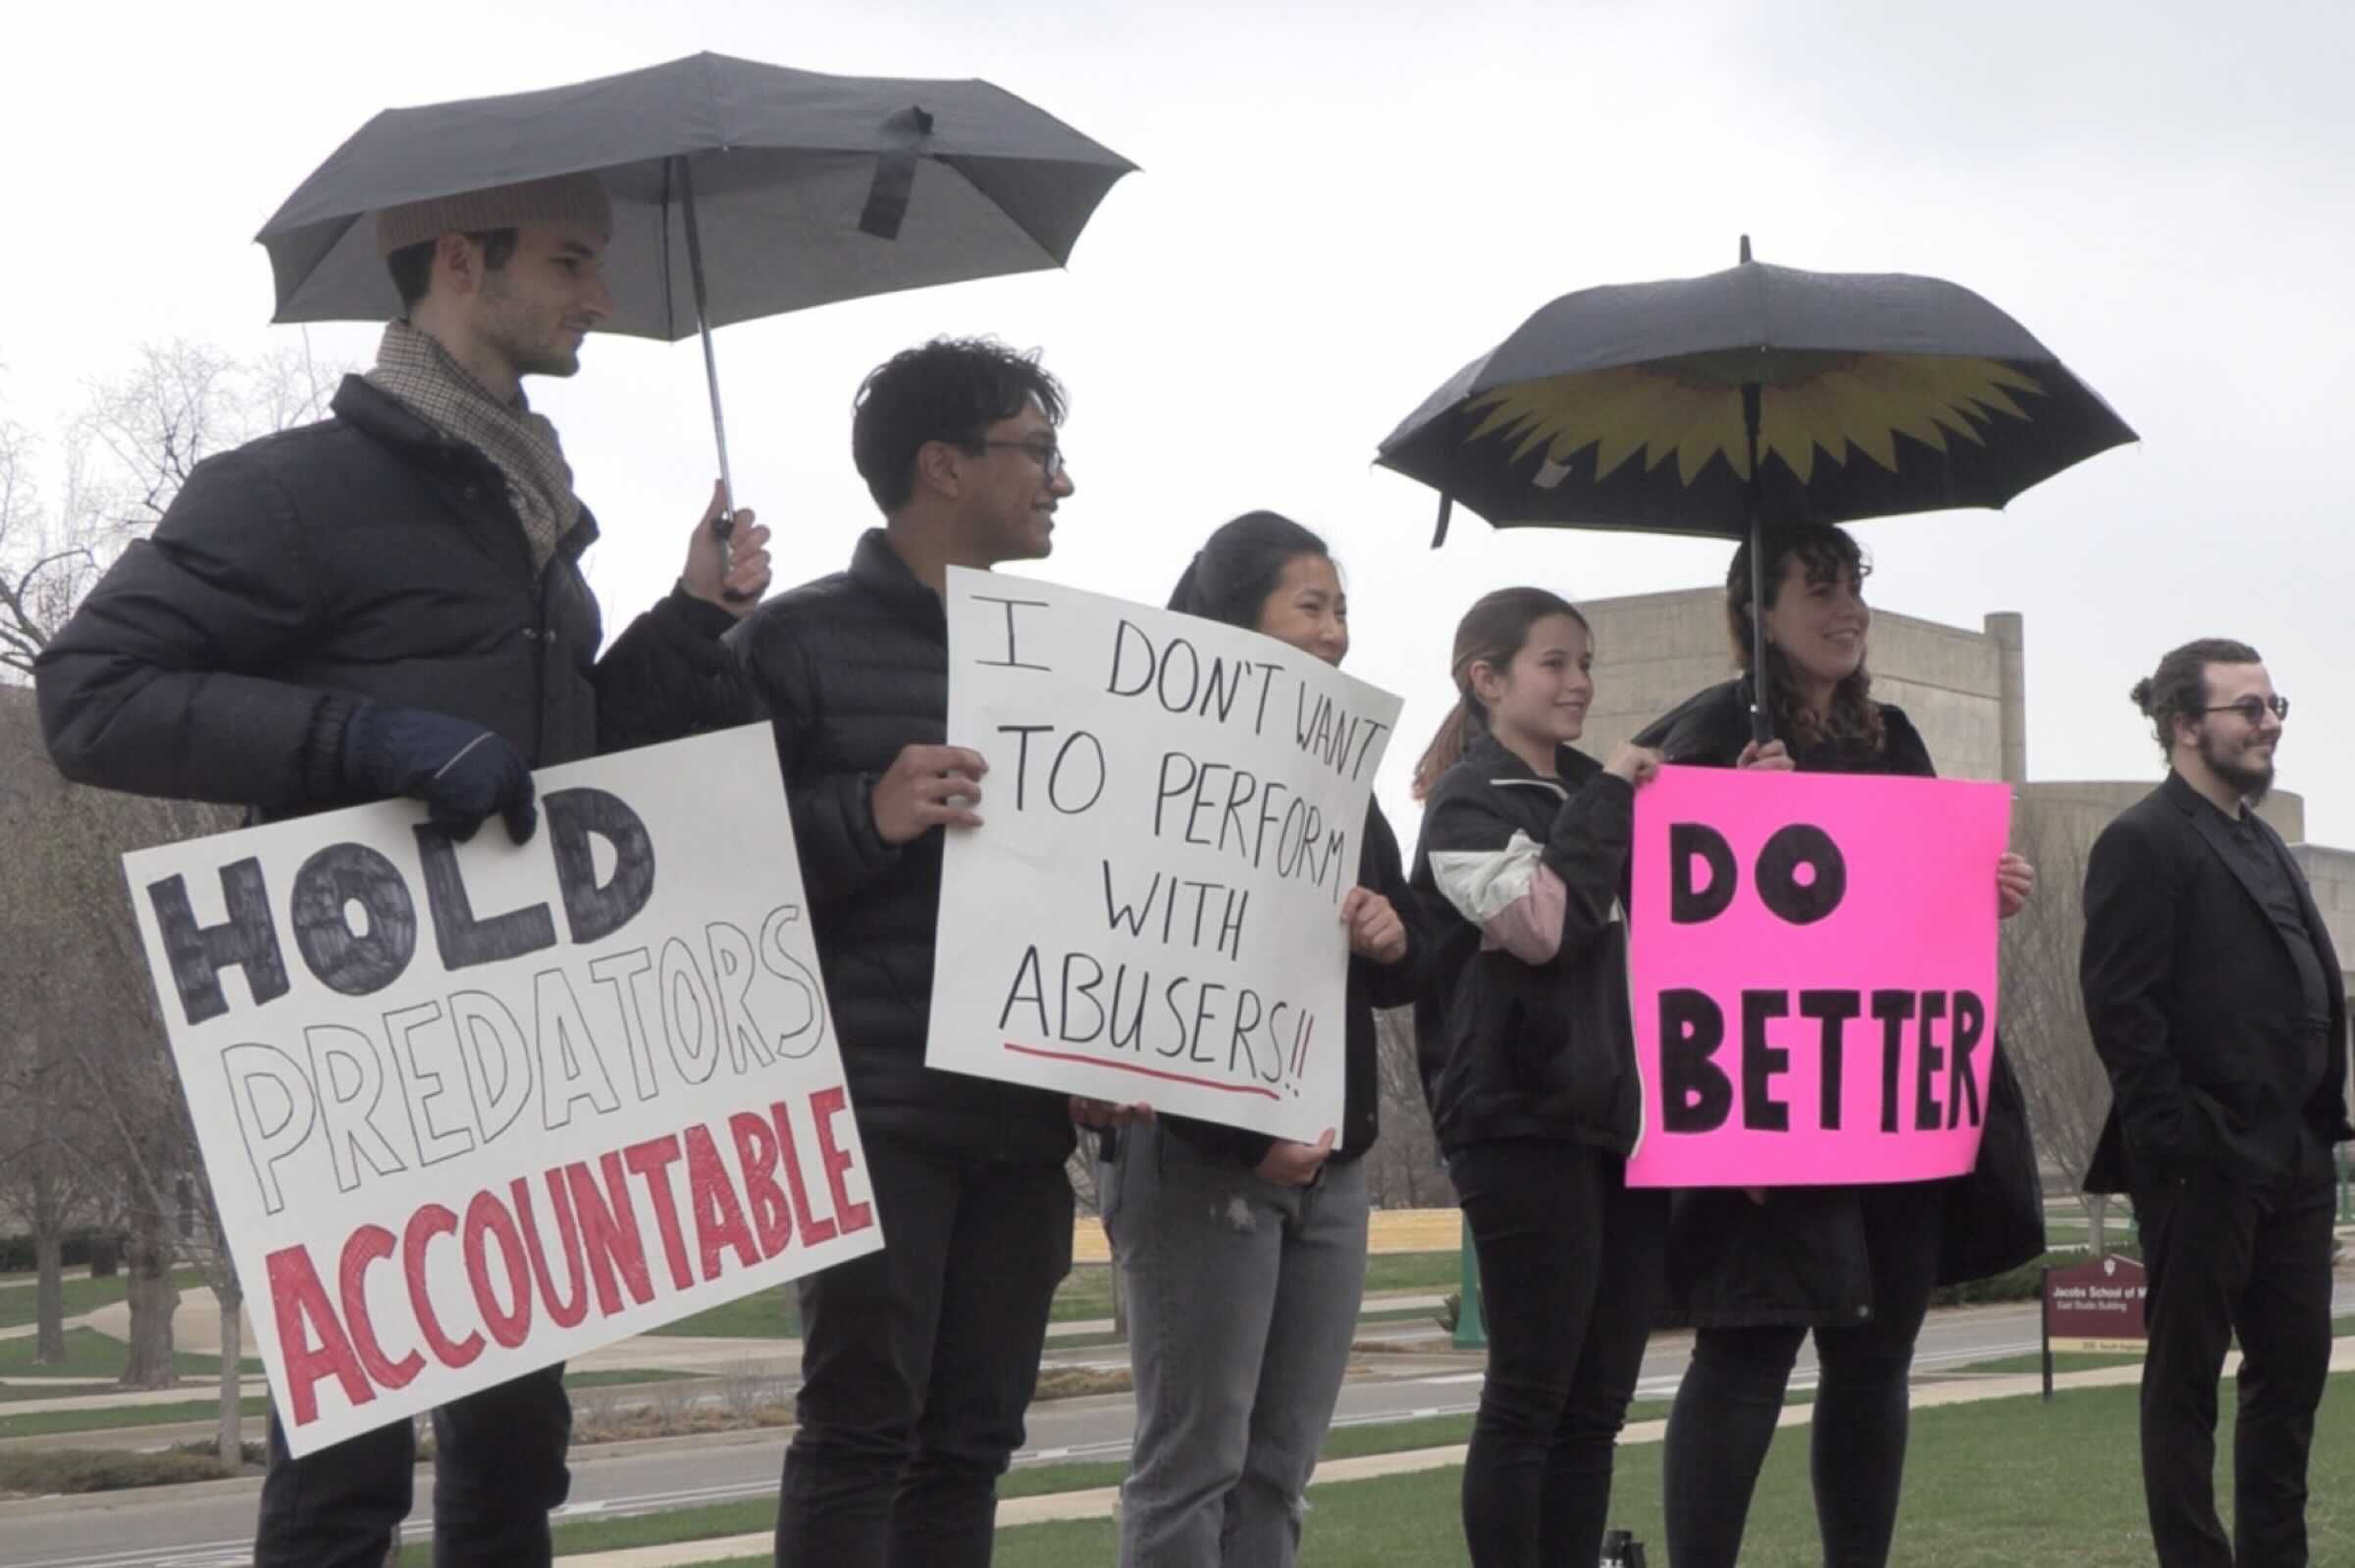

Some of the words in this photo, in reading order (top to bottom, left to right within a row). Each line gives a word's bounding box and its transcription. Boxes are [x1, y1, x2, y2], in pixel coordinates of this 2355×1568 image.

[969, 596, 1052, 671] I
[1106, 619, 1284, 735] DON'T
[1295, 679, 1388, 781] WANT
[997, 724, 1106, 814] TO
[1155, 752, 1345, 904] PERFORM
[1670, 821, 1848, 926] DO
[147, 787, 655, 1025] HOLD
[1102, 860, 1249, 962] WITH
[221, 905, 824, 1215] PREDATORS
[999, 944, 1315, 1097] ABUSERS!!
[1657, 987, 1985, 1134] BETTER
[265, 1086, 872, 1428] ACCOUNTABLE
[2053, 1286, 2086, 1298] Jacobs
[2089, 1286, 2121, 1298] School
[2124, 1286, 2134, 1298] of
